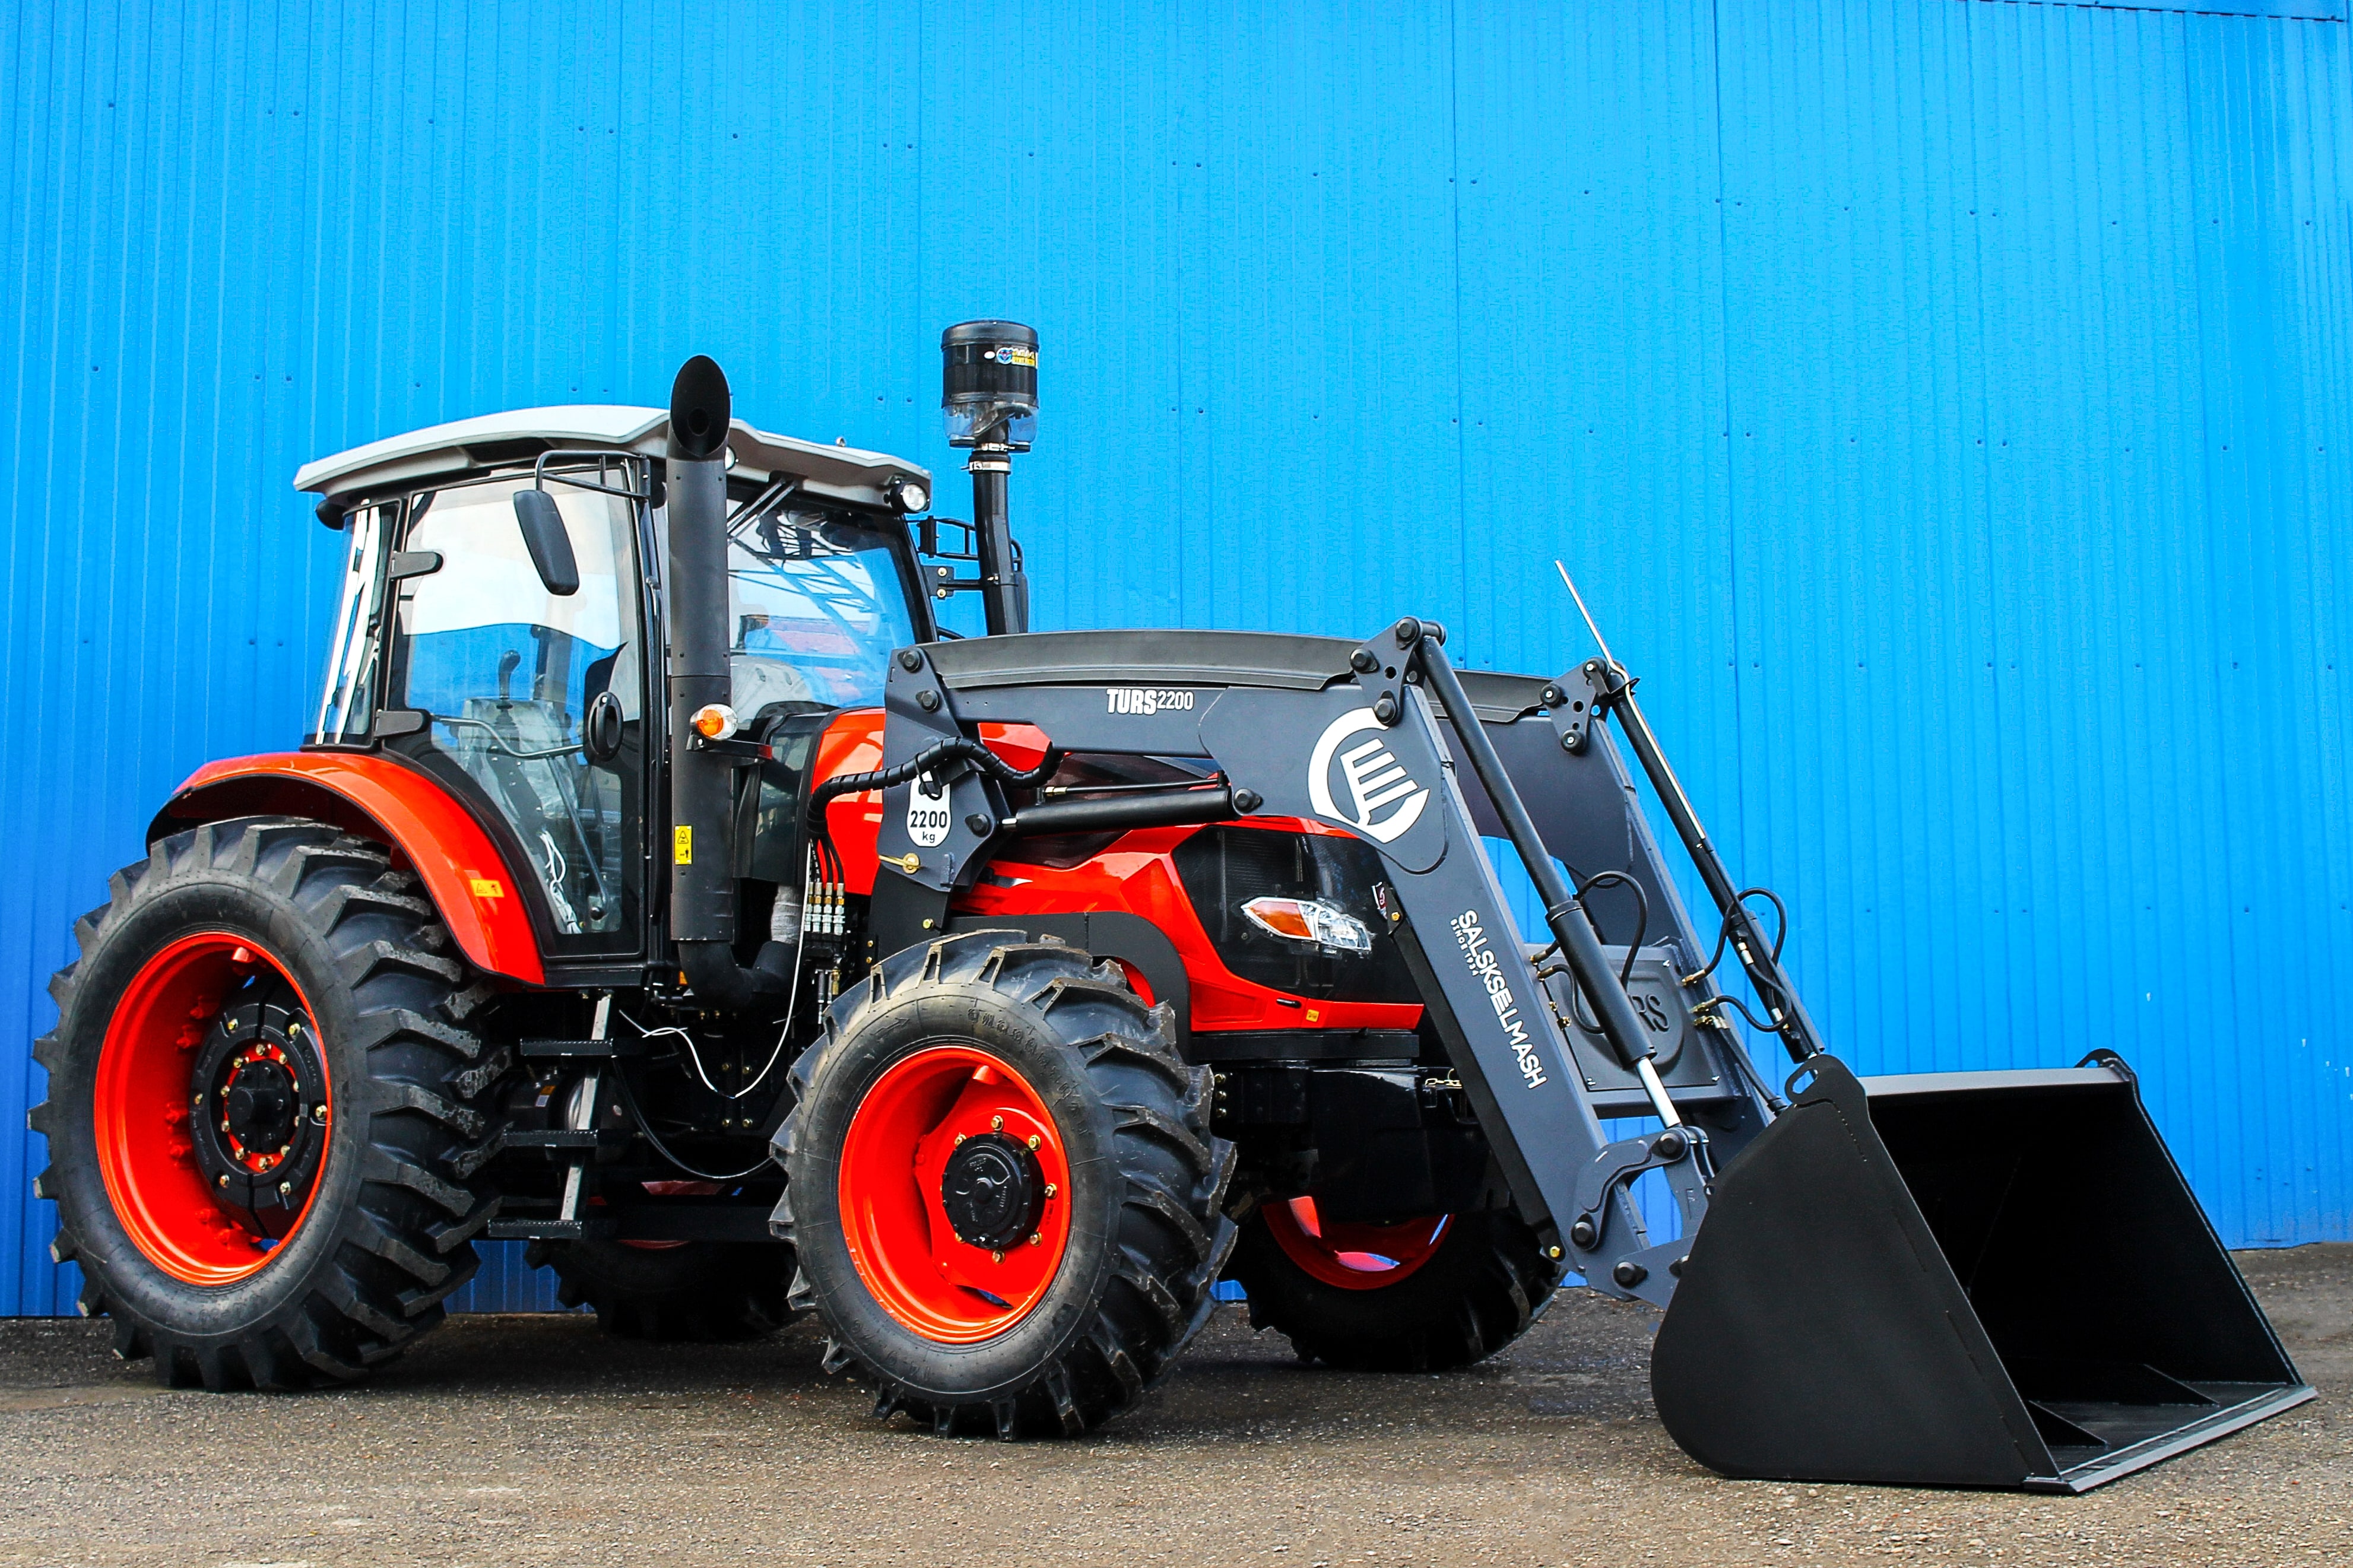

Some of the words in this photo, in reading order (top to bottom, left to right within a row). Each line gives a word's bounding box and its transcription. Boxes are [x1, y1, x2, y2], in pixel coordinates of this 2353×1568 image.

[910, 810, 947, 828] 2200
[922, 831, 936, 843] kg
[1464, 953, 1479, 976] 1934
[1458, 909, 1547, 1090] SALSKSELMASH
[1628, 994, 1670, 1033] RS
